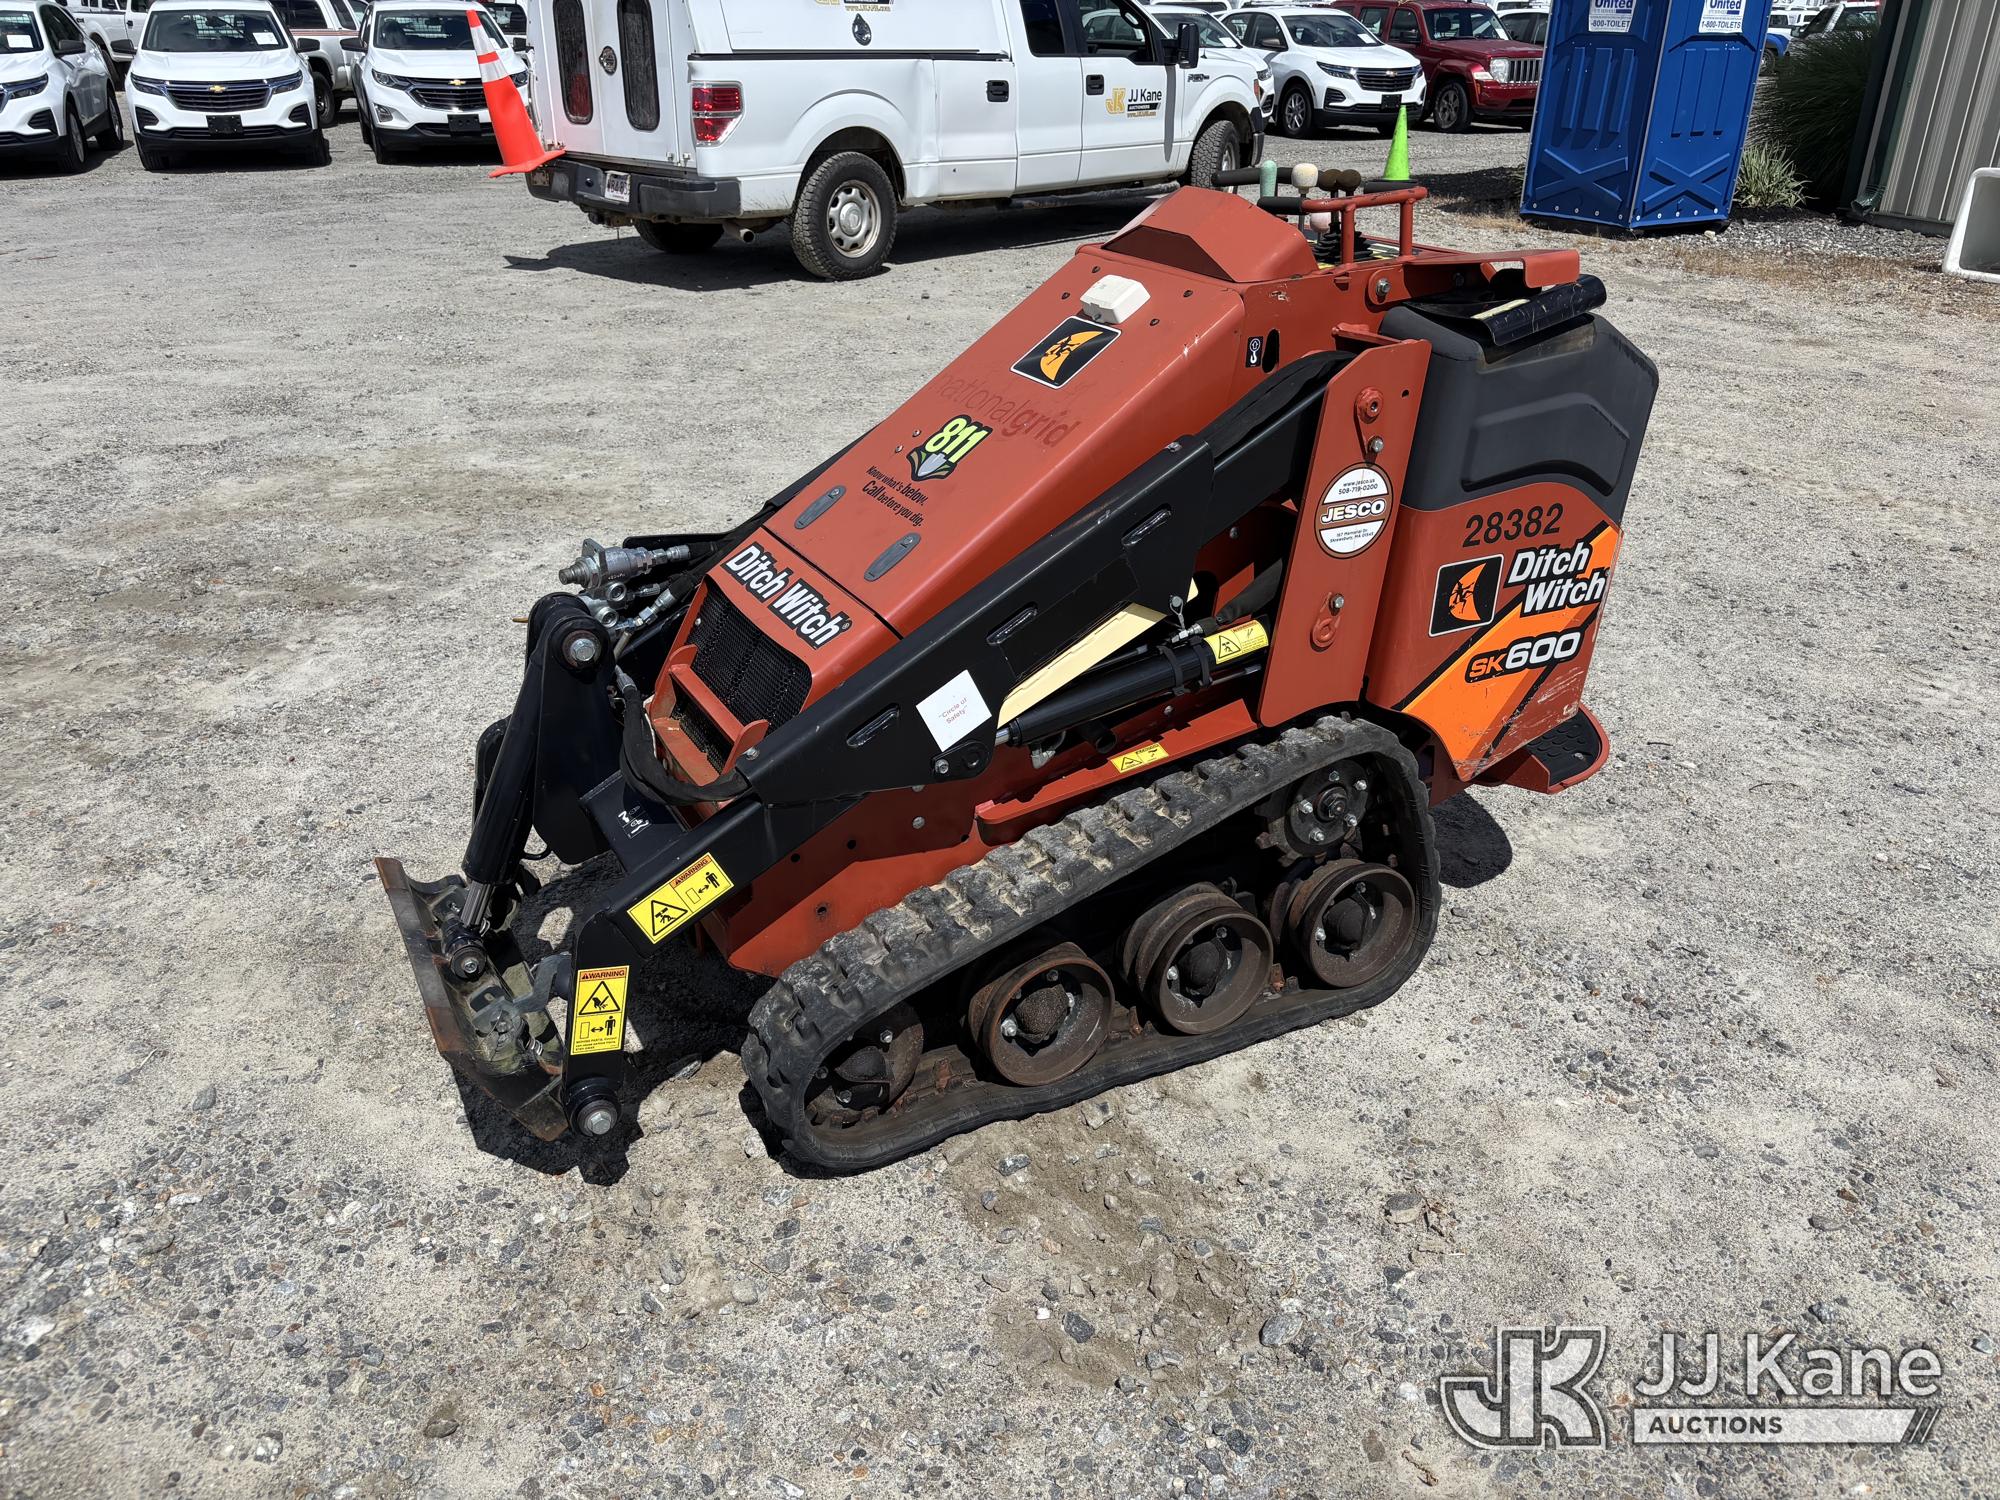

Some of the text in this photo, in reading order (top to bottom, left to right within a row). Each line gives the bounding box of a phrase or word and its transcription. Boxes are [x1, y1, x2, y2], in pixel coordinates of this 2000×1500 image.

[1710, 0, 1742, 9] United
[1128, 88, 1162, 102] JJ Kane
[925, 417, 988, 463] 811
[862, 480, 885, 498] Call
[878, 492, 901, 511] before
[901, 483, 928, 506] below.
[1321, 499, 1385, 524] JESCO
[1462, 503, 1563, 548] 28382
[726, 545, 789, 599] Ditch
[1508, 542, 1590, 584] Ditch
[1523, 571, 1607, 614] Witch
[681, 859, 708, 881] WARNING
[588, 970, 625, 979] WARNING
